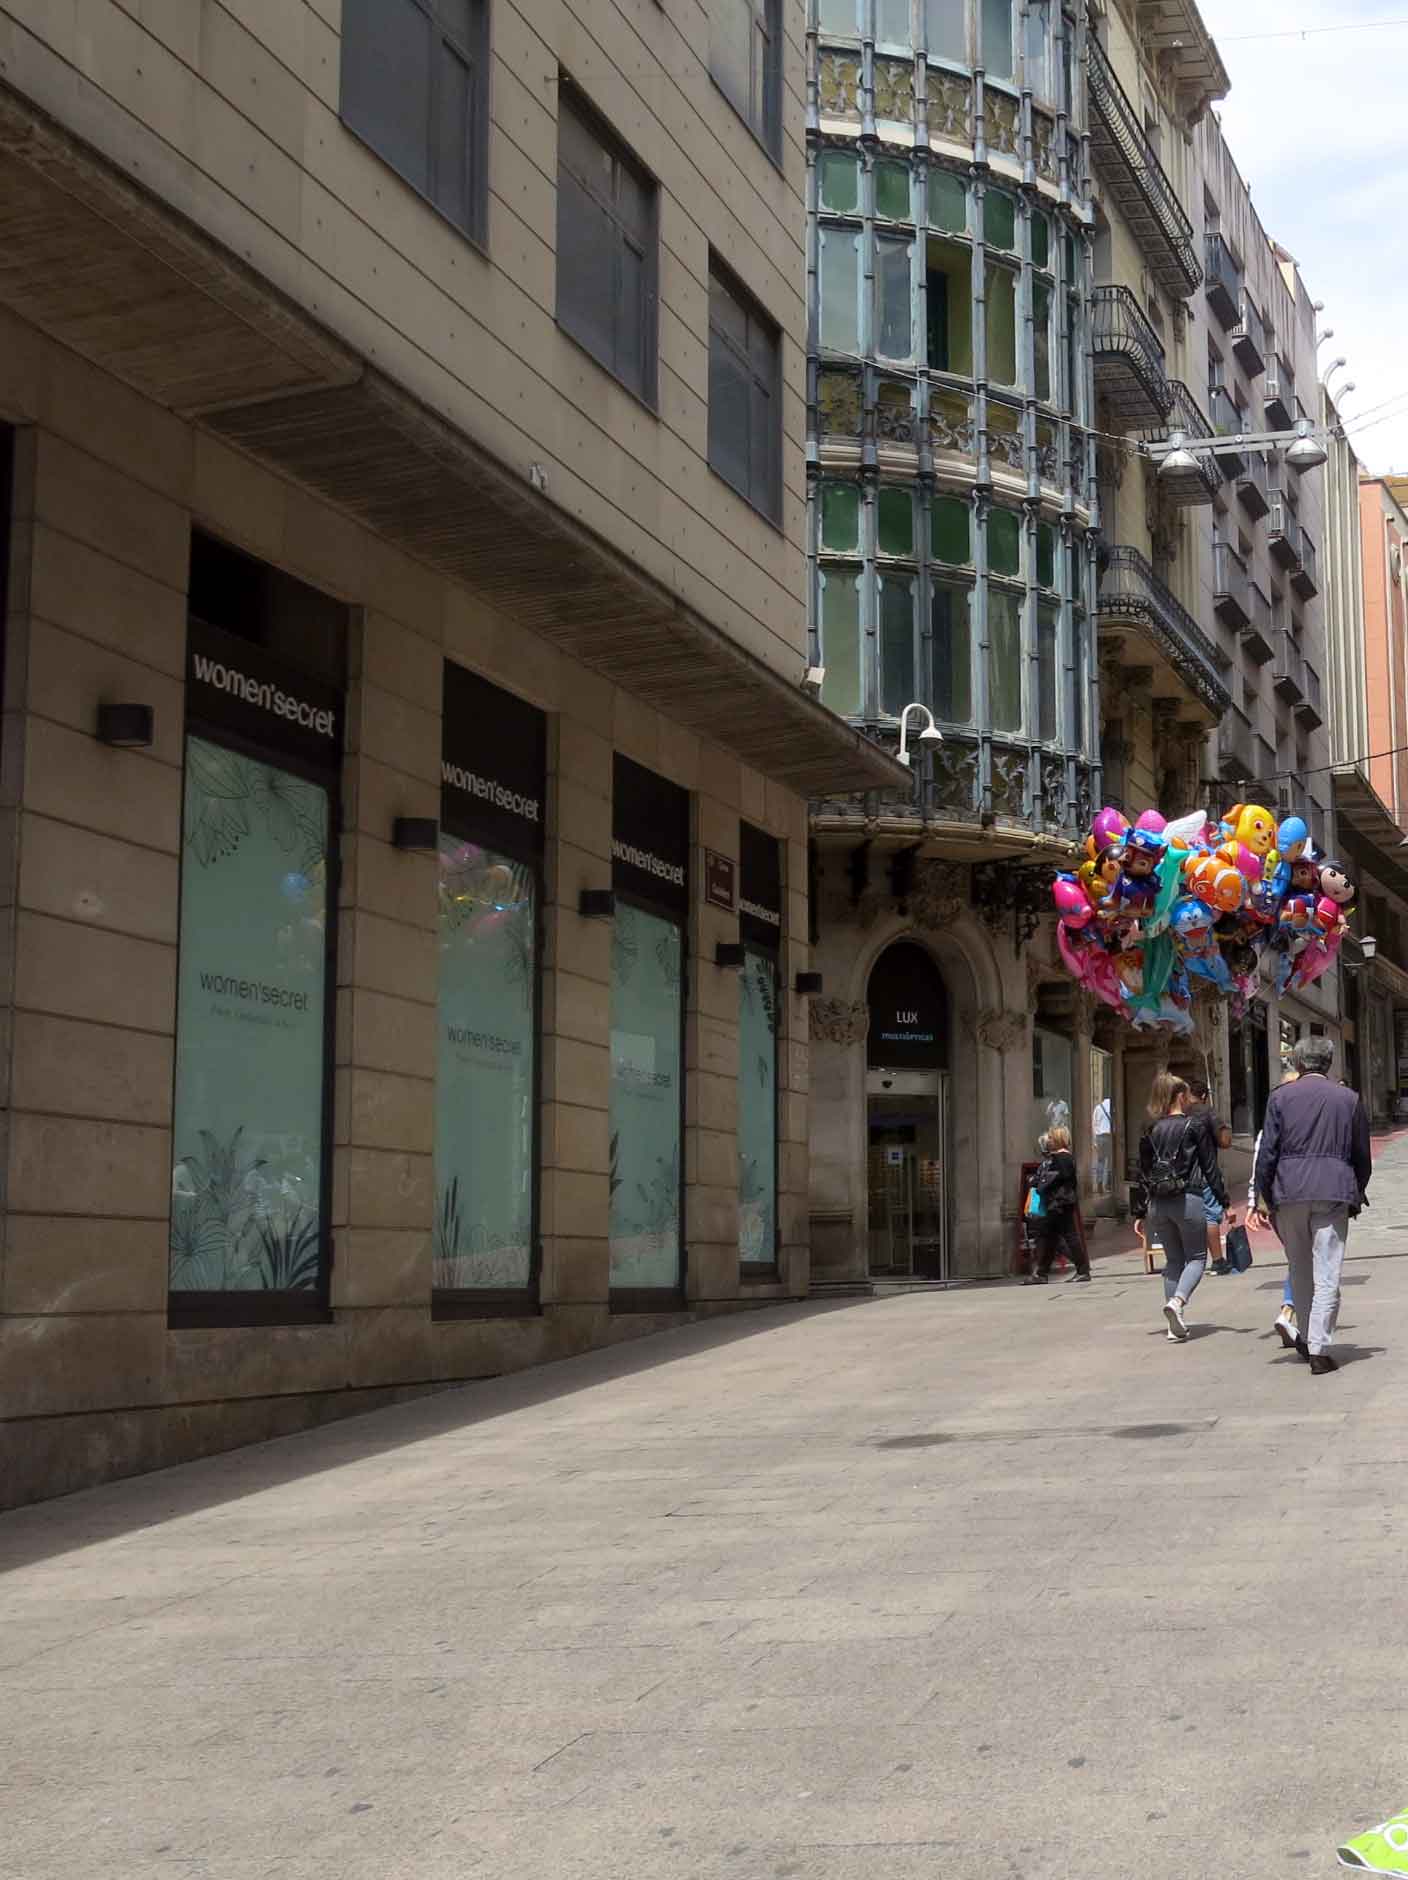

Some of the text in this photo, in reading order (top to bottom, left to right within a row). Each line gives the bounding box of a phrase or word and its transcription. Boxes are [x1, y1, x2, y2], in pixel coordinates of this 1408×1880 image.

[192, 653, 336, 737] women'secret
[441, 761, 539, 821] women'secret
[200, 970, 309, 1012] women'secret
[896, 1010, 919, 1024] LUX
